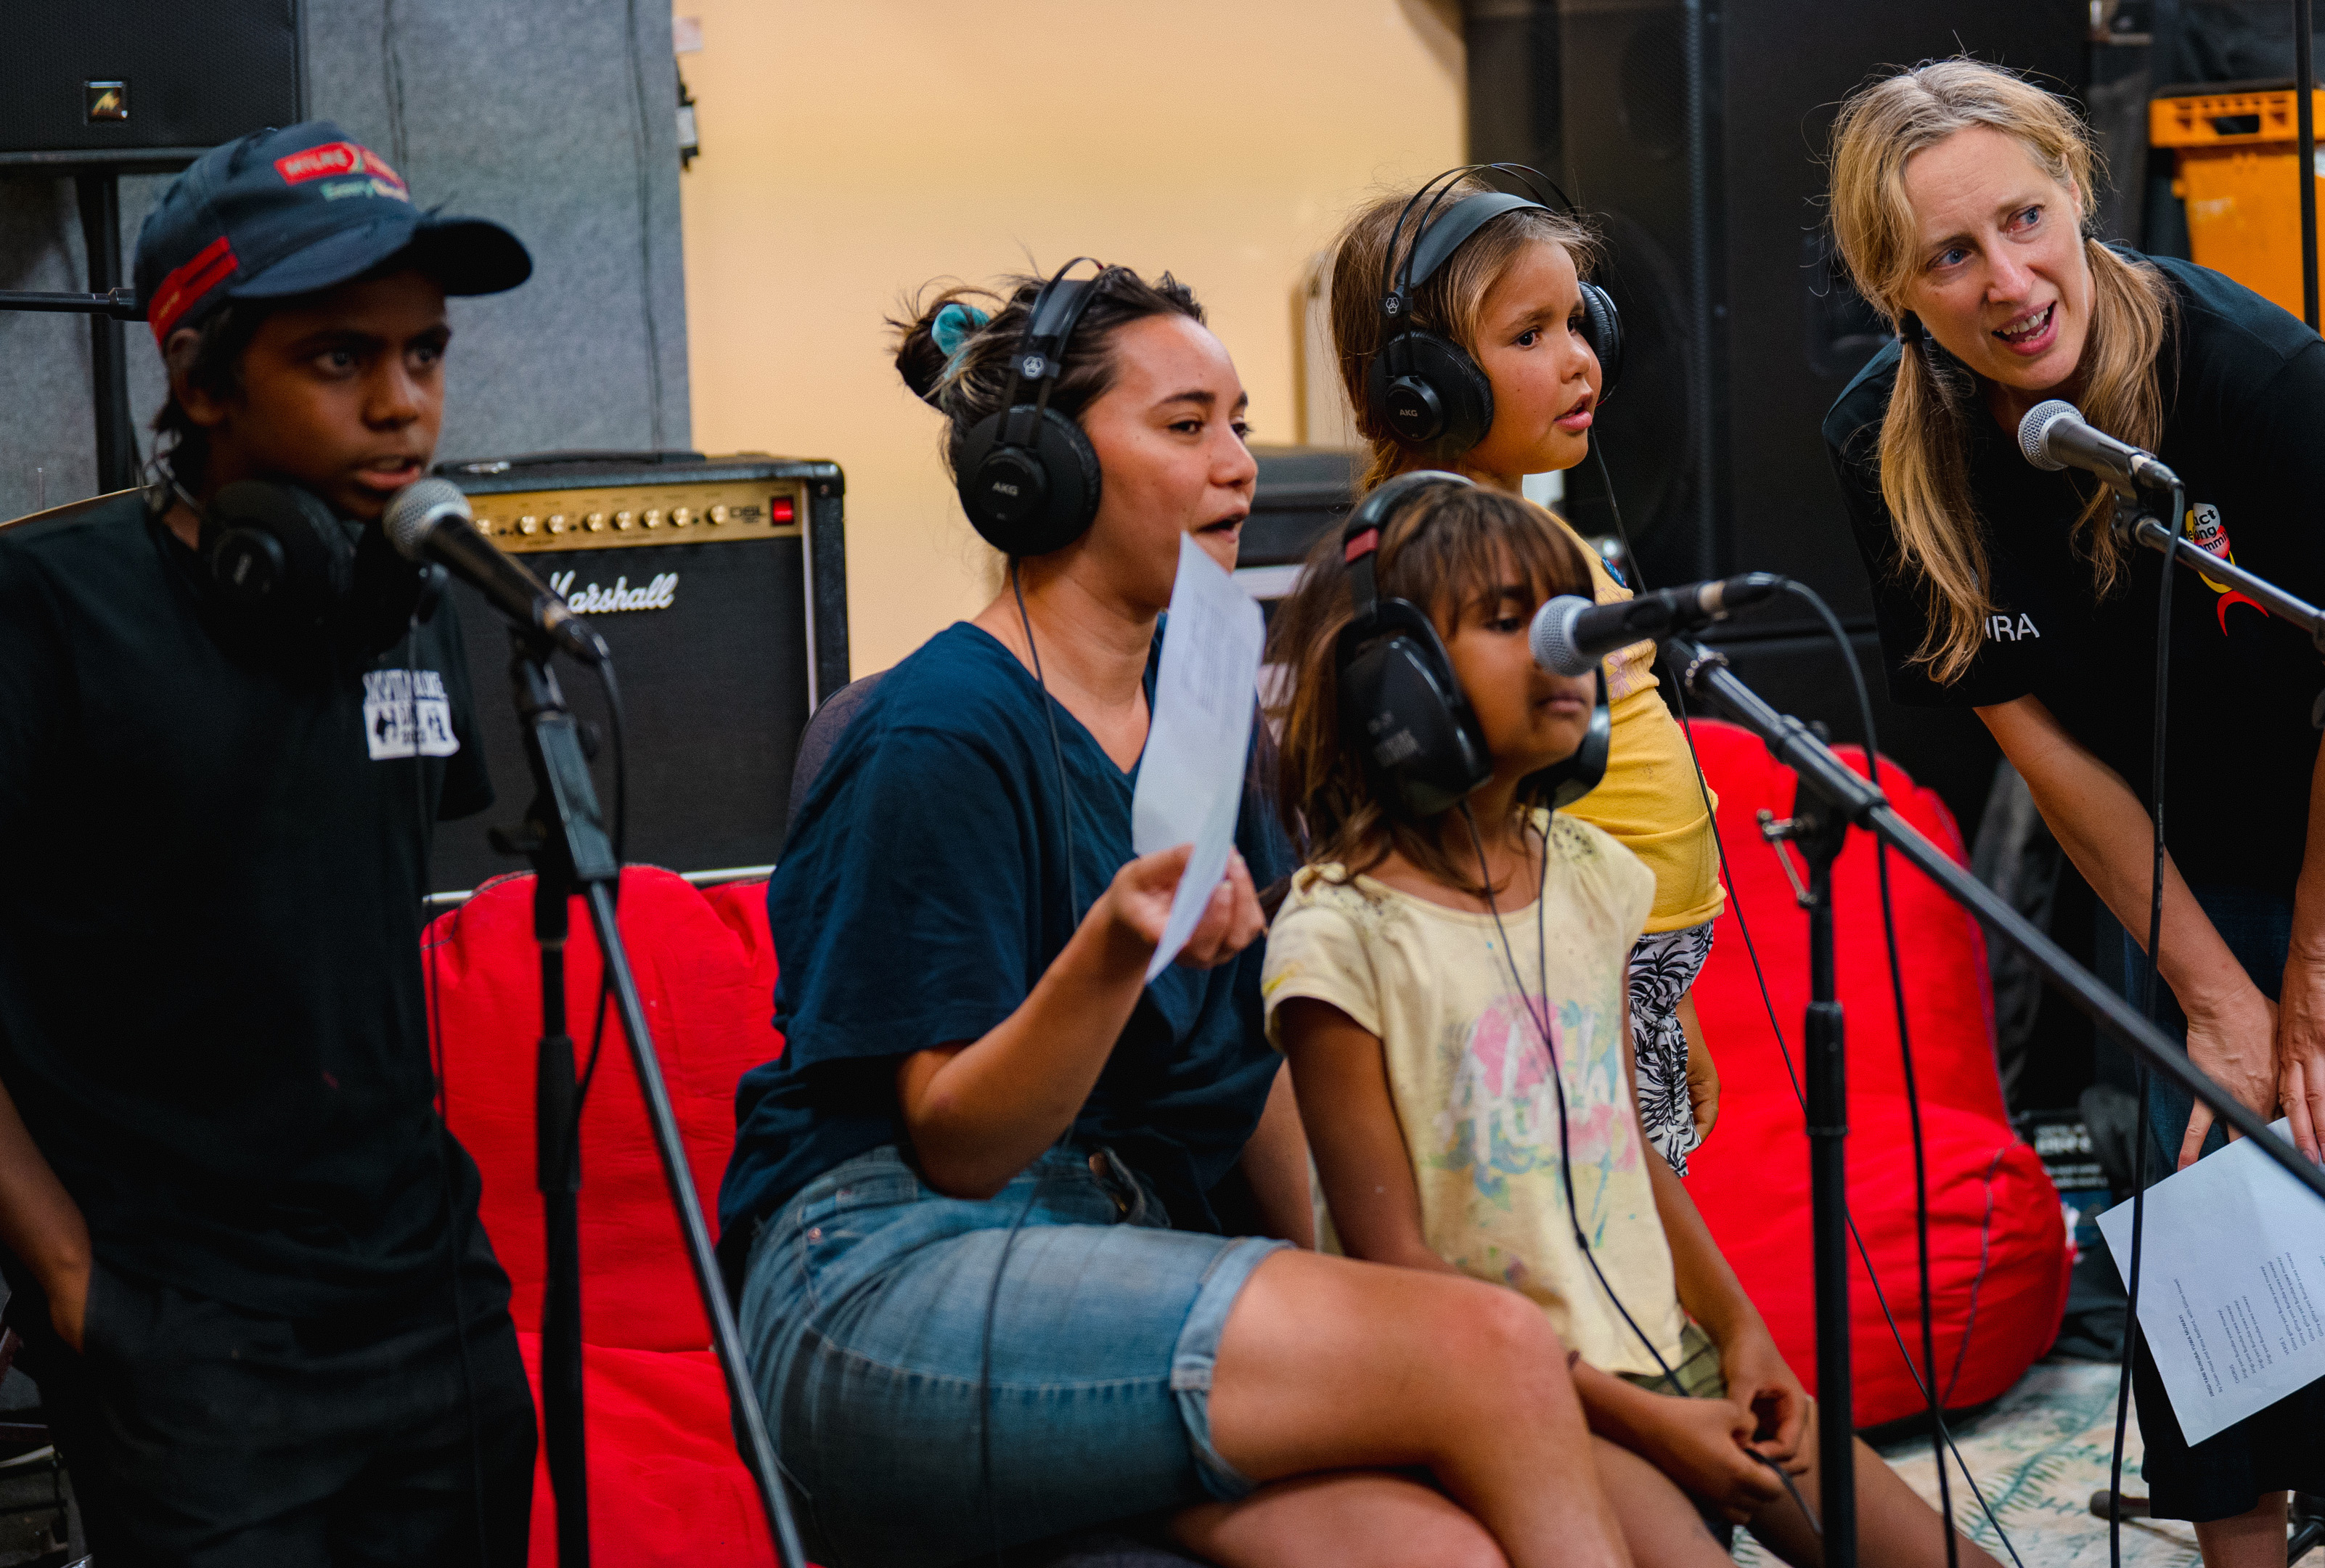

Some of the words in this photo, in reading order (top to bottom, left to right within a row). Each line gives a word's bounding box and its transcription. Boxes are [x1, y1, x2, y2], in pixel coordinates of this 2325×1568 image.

[1400, 409, 1418, 417] AKG
[992, 481, 1018, 497] AKG
[2186, 526, 2218, 541] elng
